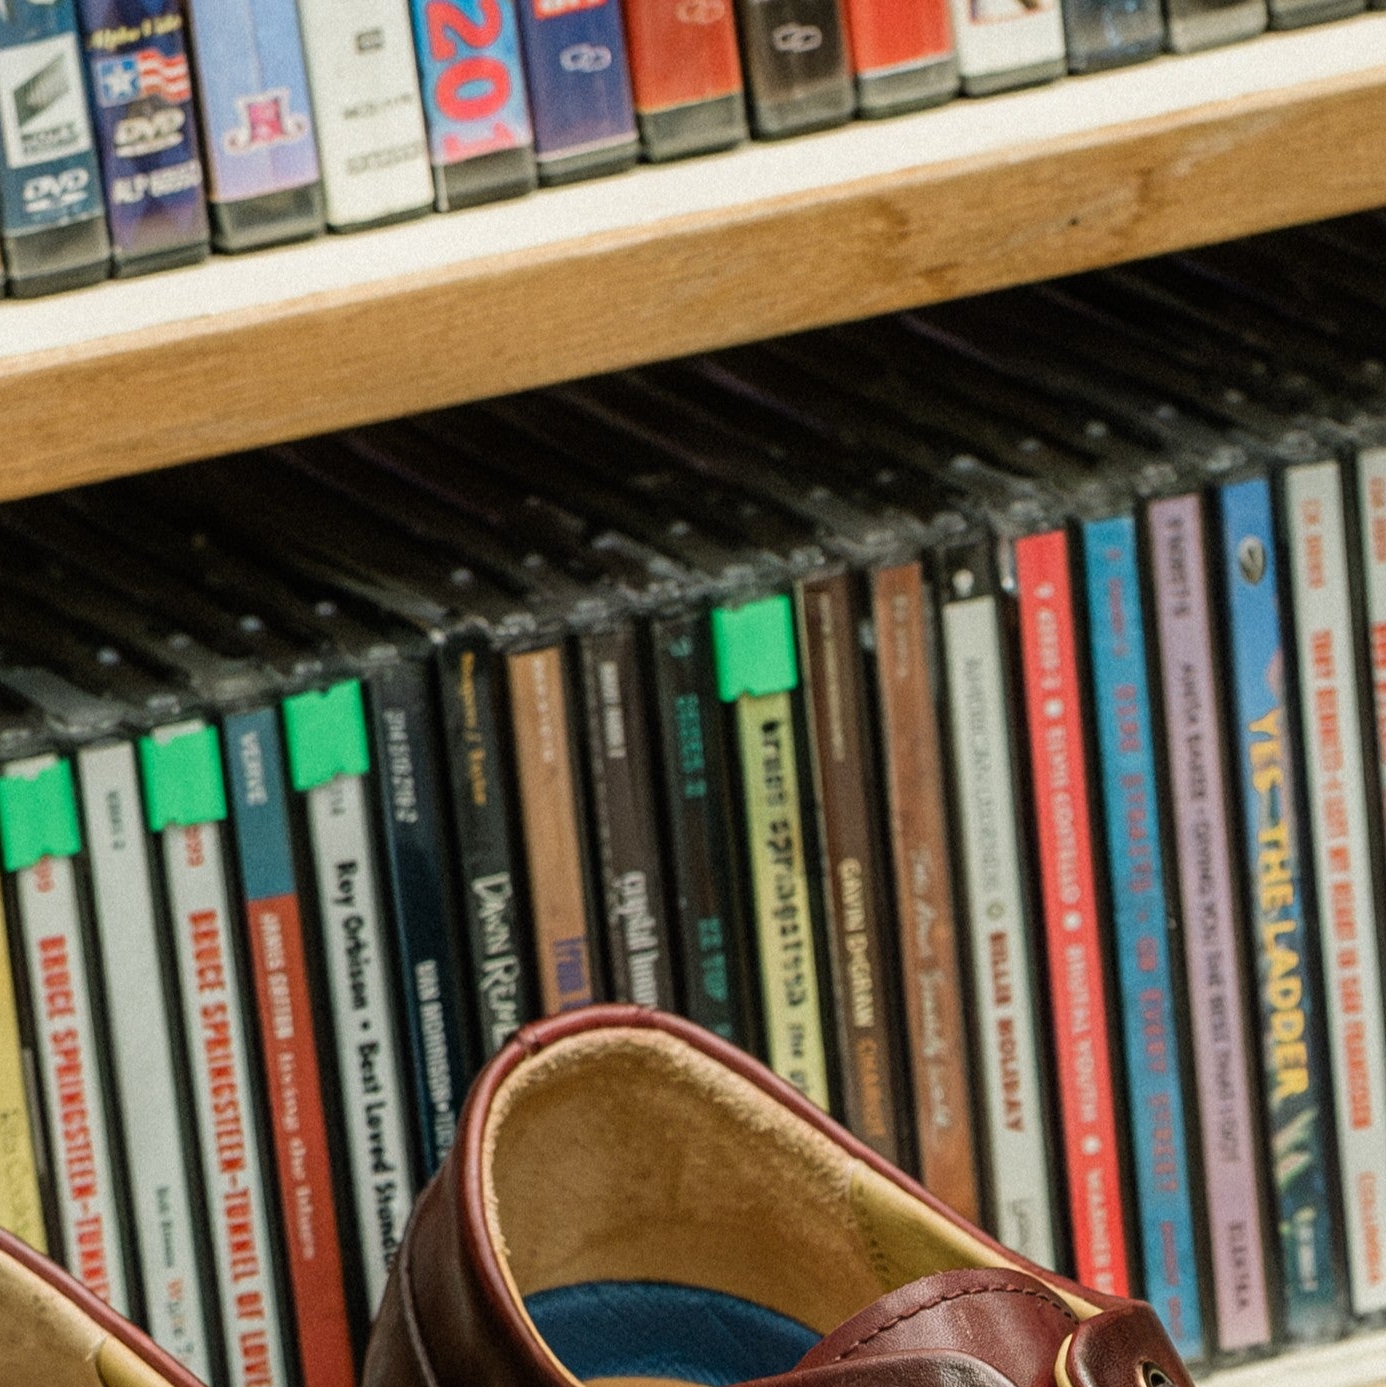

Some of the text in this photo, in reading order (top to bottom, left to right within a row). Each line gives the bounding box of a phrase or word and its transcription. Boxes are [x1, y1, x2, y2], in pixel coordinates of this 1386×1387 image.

[236, 730, 270, 808] VERVE
[468, 870, 520, 957] DAWN
[835, 856, 870, 932] GAVIN
[1244, 707, 1311, 1102] YES THE LADDER
[35, 933, 78, 1021] BRUCE
[326, 858, 394, 1174] Roy Orbison Best Loved
[412, 958, 441, 1003] VAN
[984, 929, 1027, 1134] BILLIE HOLIDAY
[185, 907, 230, 995] BRUCE
[230, 1289, 267, 1321] OF
